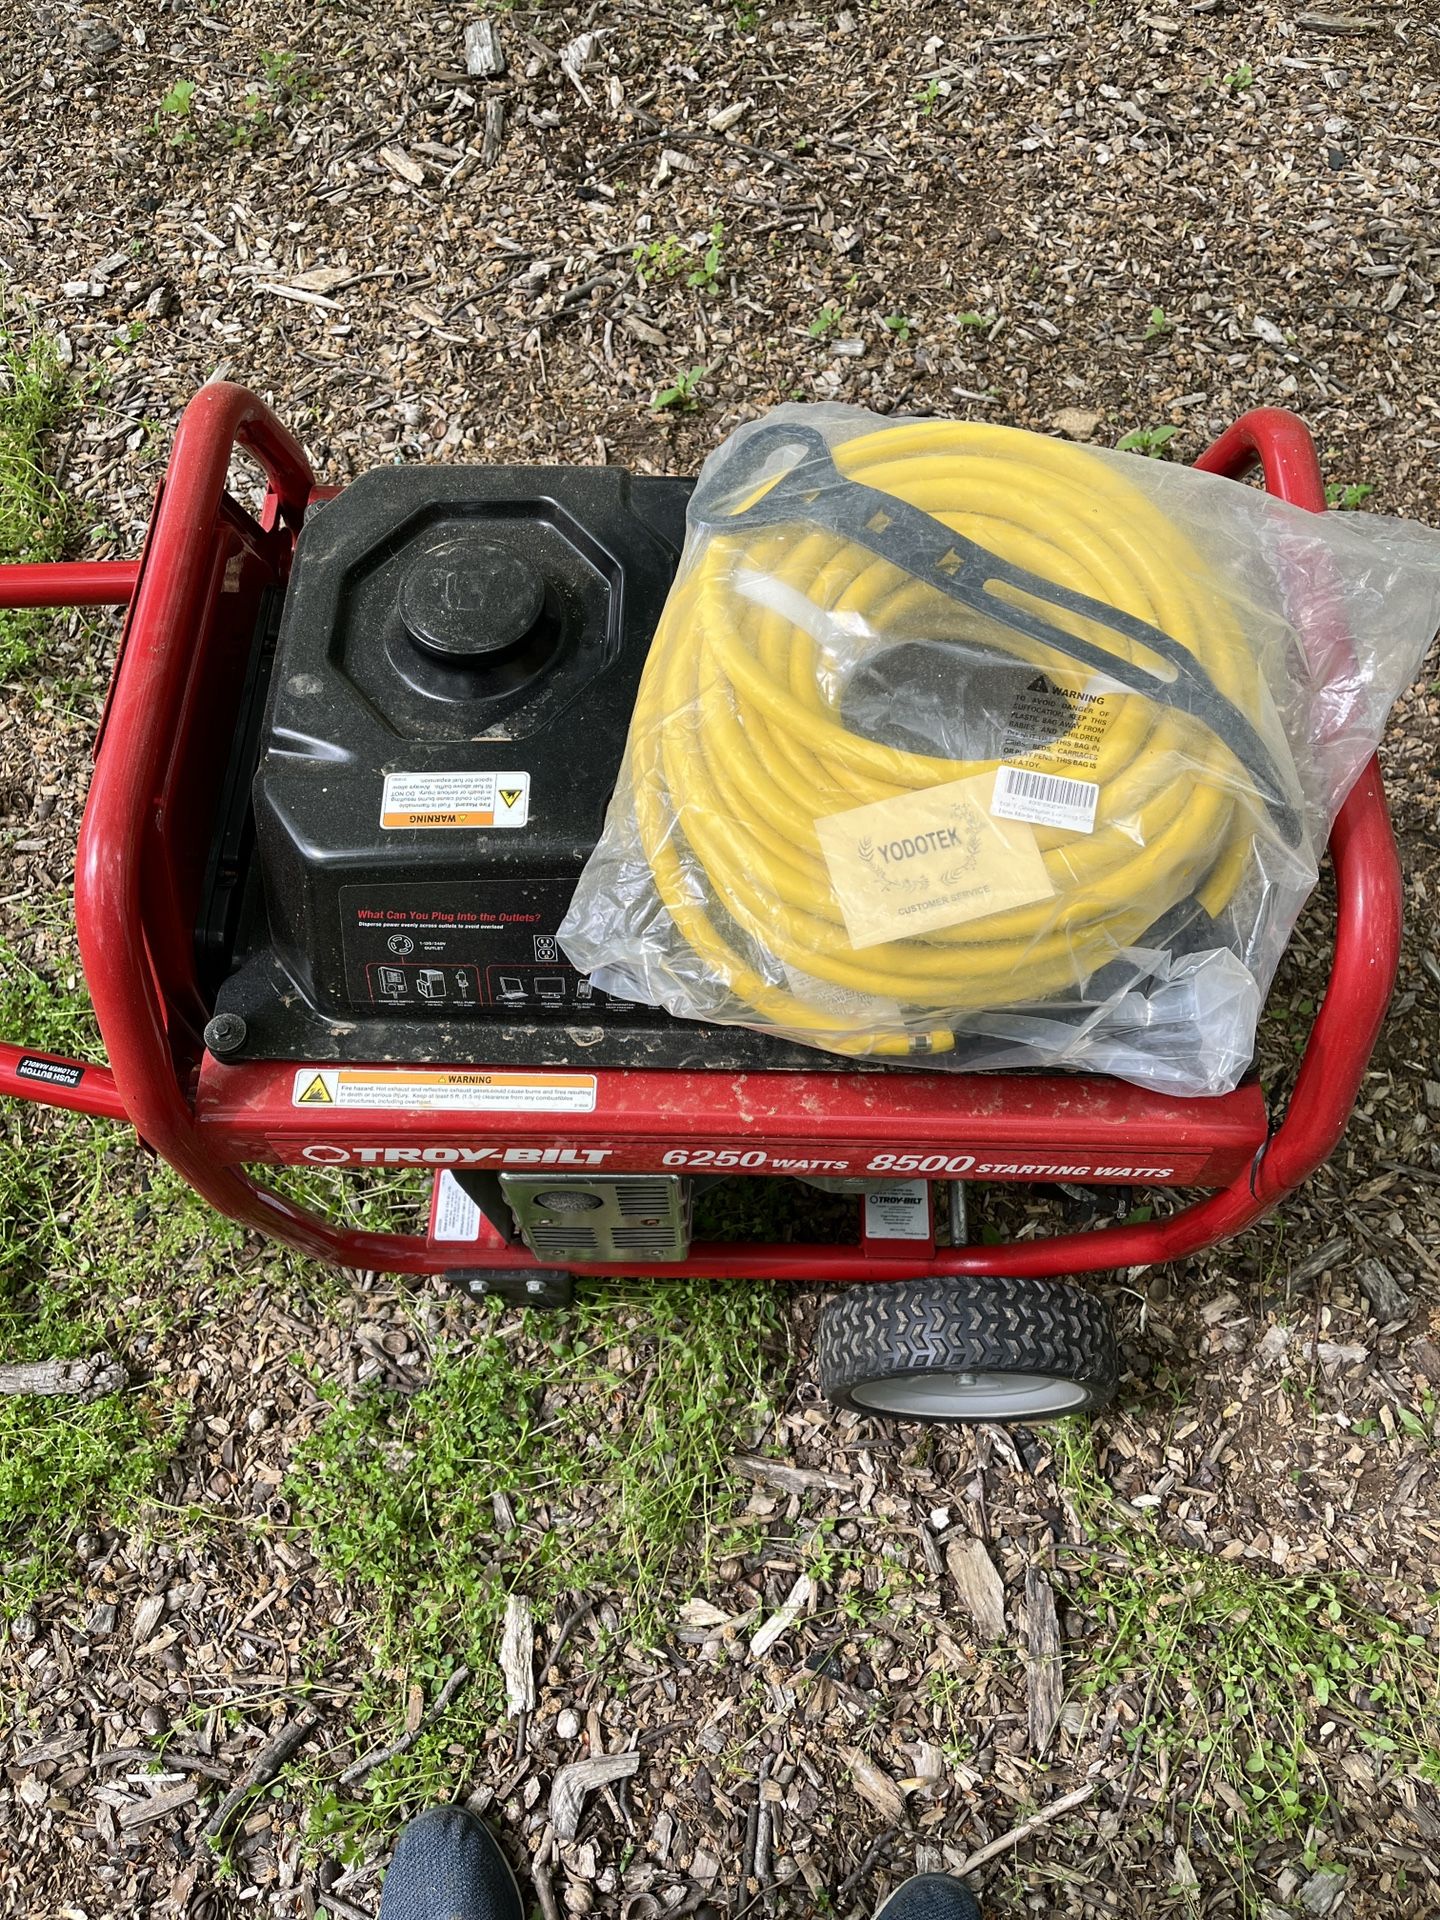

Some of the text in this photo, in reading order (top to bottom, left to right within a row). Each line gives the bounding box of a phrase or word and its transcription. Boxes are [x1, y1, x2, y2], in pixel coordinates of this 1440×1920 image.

[1052, 687, 1105, 705] WARNING
[1032, 698, 1056, 707] AVOID
[1061, 703, 1094, 713] DANGER
[1011, 711, 1104, 734] PLASTIC BAG AWAY FROM
[1070, 713, 1087, 721] KEEP
[1009, 721, 1035, 730] BABIES
[1041, 726, 1057, 735] AND
[1056, 738, 1072, 747] THIS
[1074, 742, 1089, 750] BAG
[1056, 757, 1073, 765] THIS
[409, 815, 456, 823] WARNING
[877, 827, 962, 864] YODOTEK
[897, 885, 991, 916] CUSTOMER SERVICE
[357, 910, 541, 922] What Can You Plug Into the Outlets?
[22, 1059, 50, 1071] HANDLE
[49, 1065, 71, 1075] LOWER
[20, 1066, 76, 1084] PUSH BUTTON
[448, 1075, 492, 1084] WARNING
[352, 1147, 613, 1165] TROY-BILT
[662, 1149, 1175, 1180] 6250 WATTS 8500 STARTING WATTS
[879, 1196, 923, 1204] TROY-BILT
